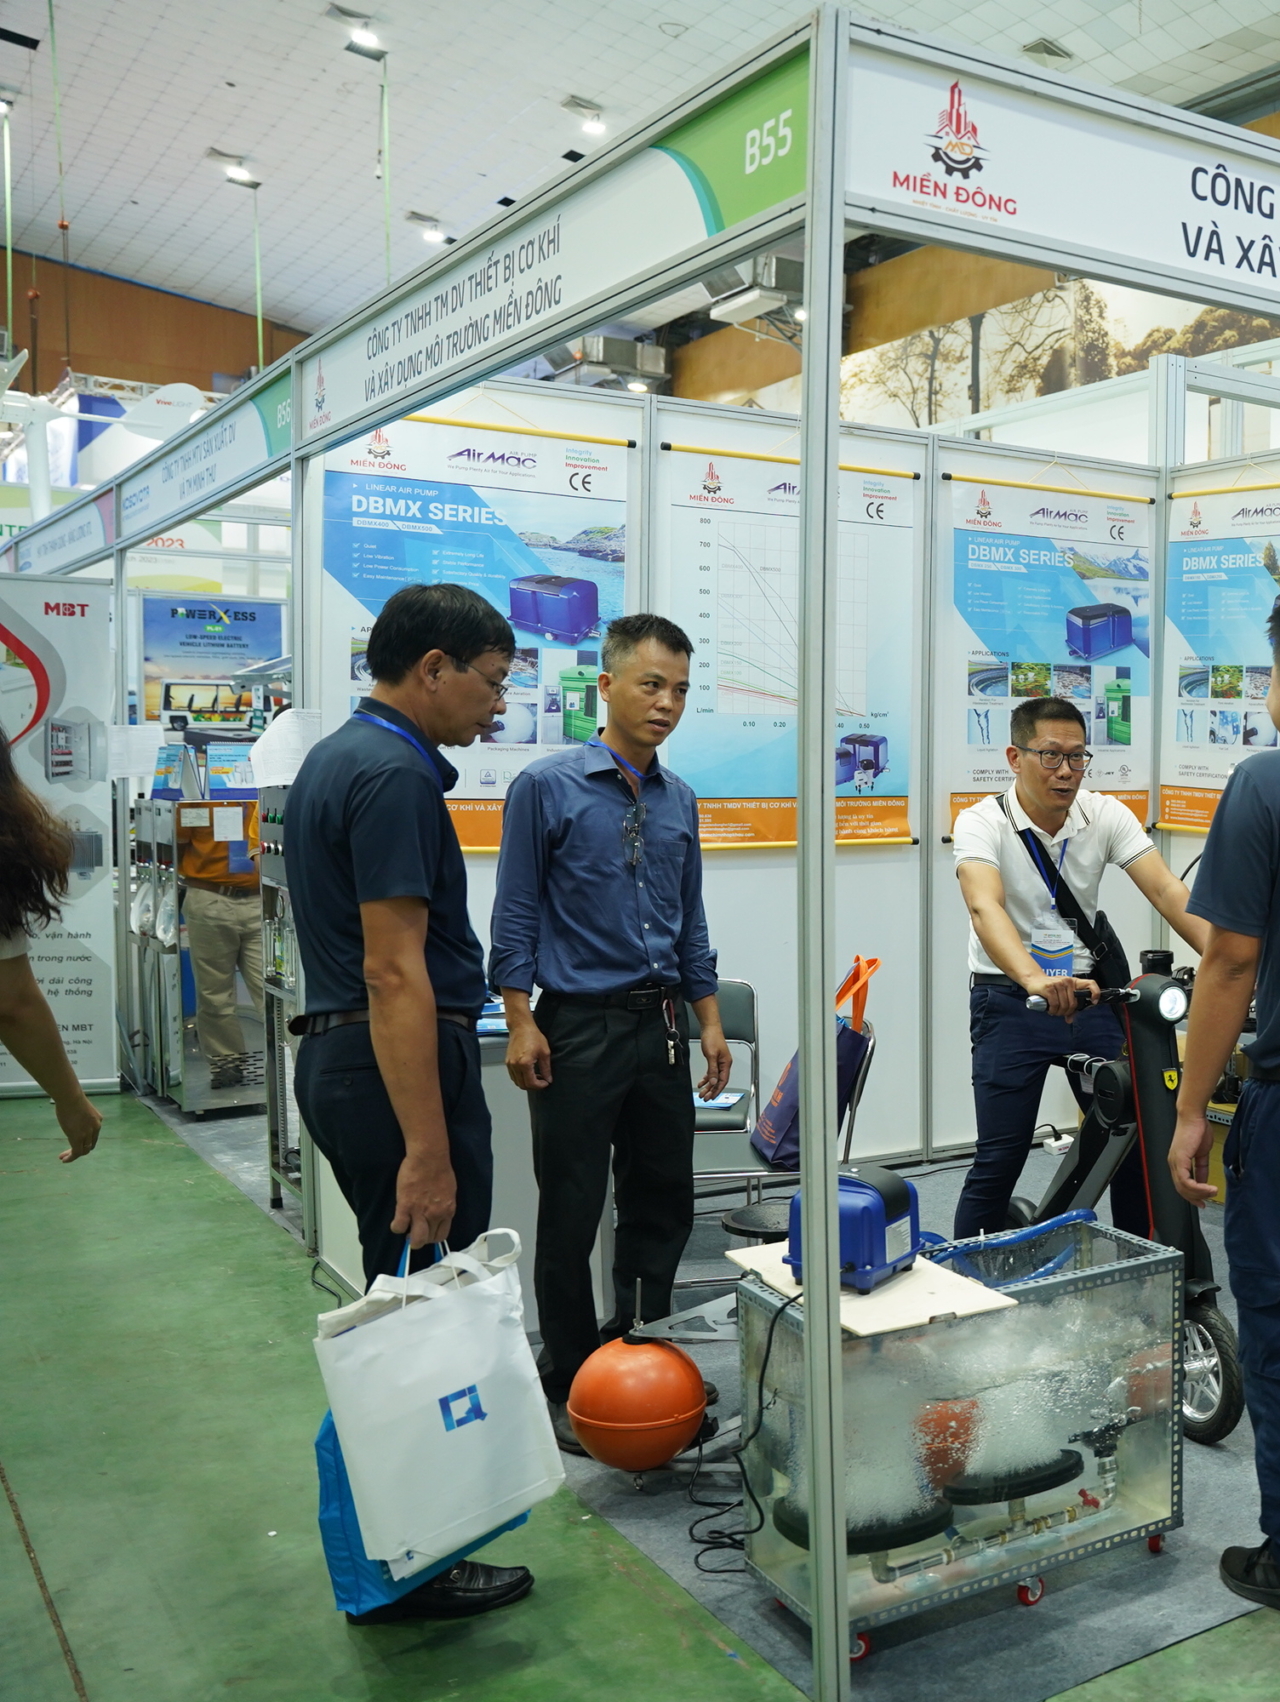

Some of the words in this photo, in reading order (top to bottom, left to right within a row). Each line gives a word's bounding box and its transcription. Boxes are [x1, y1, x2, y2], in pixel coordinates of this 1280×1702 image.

[745, 108, 792, 174] B55
[892, 171, 948, 200] MIỀN
[954, 185, 1018, 215] ĐÔNG
[1191, 163, 1275, 219] CÔNG
[1181, 220, 1226, 265] VÀ
[367, 328, 389, 360] CÔNG
[392, 317, 402, 347] TY
[405, 300, 432, 339] TNHH
[434, 290, 448, 322] TM
[452, 280, 465, 313] DV
[468, 250, 500, 302] THIẾT
[504, 250, 515, 287] BỊ
[518, 238, 535, 274] CƠ
[538, 214, 561, 264] KHÍ
[364, 369, 376, 402] VÀ
[378, 362, 396, 396] XÂY
[397, 350, 423, 388] DỰNG
[425, 334, 443, 372] MÔI
[446, 313, 490, 357] TRƯỜNG
[492, 288, 522, 338] MIỀN
[525, 275, 562, 321] ĐÔNG
[446, 448, 537, 469] AirMac
[566, 448, 592, 456] Integrity
[566, 455, 600, 463] Innovation
[378, 459, 407, 472] ĐÔNG
[565, 462, 608, 471] Improvement
[366, 483, 396, 492] LINEAR
[414, 488, 438, 496] PUMP
[863, 486, 890, 494] Innovation
[863, 493, 897, 501] Improvement
[352, 495, 422, 518] DBMX
[428, 503, 507, 525] SERIES
[1029, 507, 1088, 523] AirMac
[402, 524, 432, 532] DBMX500
[968, 544, 1014, 562] DBMX
[1019, 549, 1074, 567] SERIES
[1183, 556, 1217, 571] DBMX
[1221, 553, 1264, 569] SERIES
[44, 602, 89, 617] MBT
[744, 801, 760, 809] THIẾT
[67, 931, 91, 939] hành
[65, 987, 92, 997] thống
